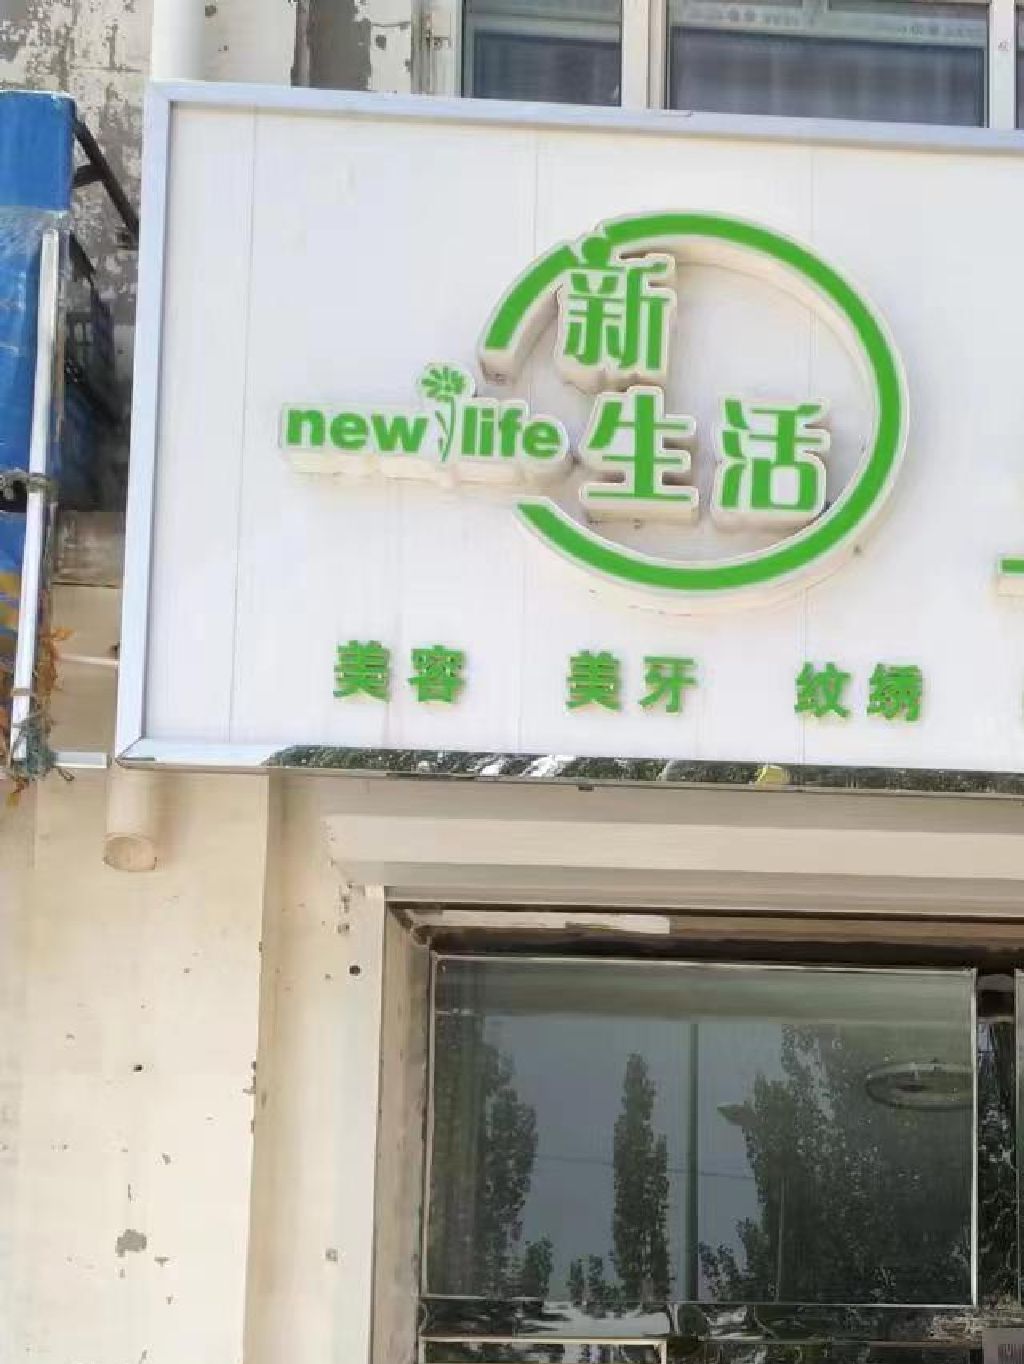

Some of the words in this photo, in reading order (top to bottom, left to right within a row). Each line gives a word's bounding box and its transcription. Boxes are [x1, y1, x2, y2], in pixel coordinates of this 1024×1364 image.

[333, 640, 466, 702] 美容
[566, 651, 697, 713] 美牙
[794, 662, 924, 722] 纹绣
